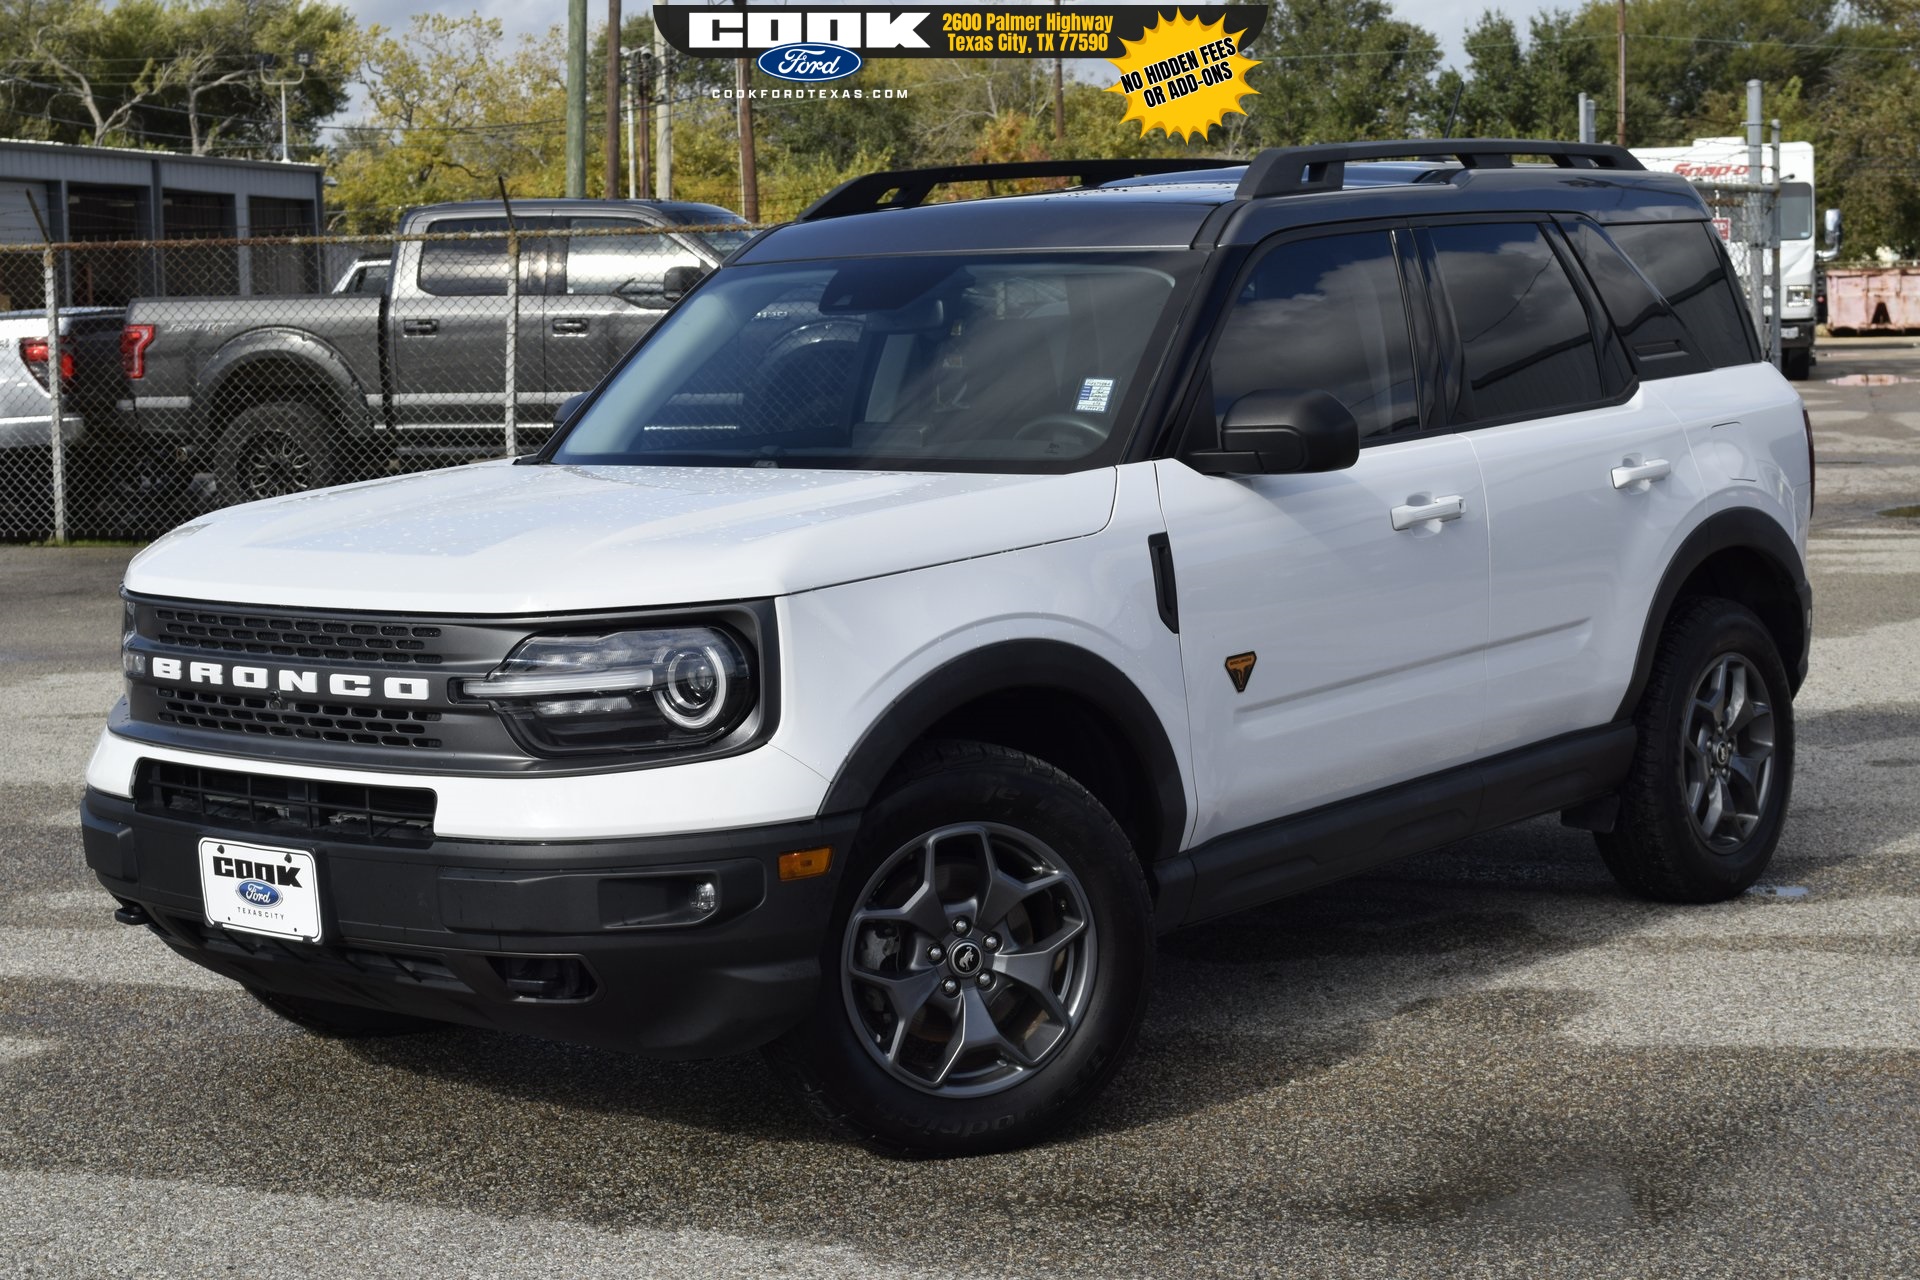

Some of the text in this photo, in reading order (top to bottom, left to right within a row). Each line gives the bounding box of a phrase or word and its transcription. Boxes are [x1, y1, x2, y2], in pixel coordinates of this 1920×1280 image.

[152, 657, 429, 700] BRONCO
[213, 857, 302, 888] COOK
[246, 884, 270, 903] Ford
[238, 907, 284, 920] TEXAS CITY
